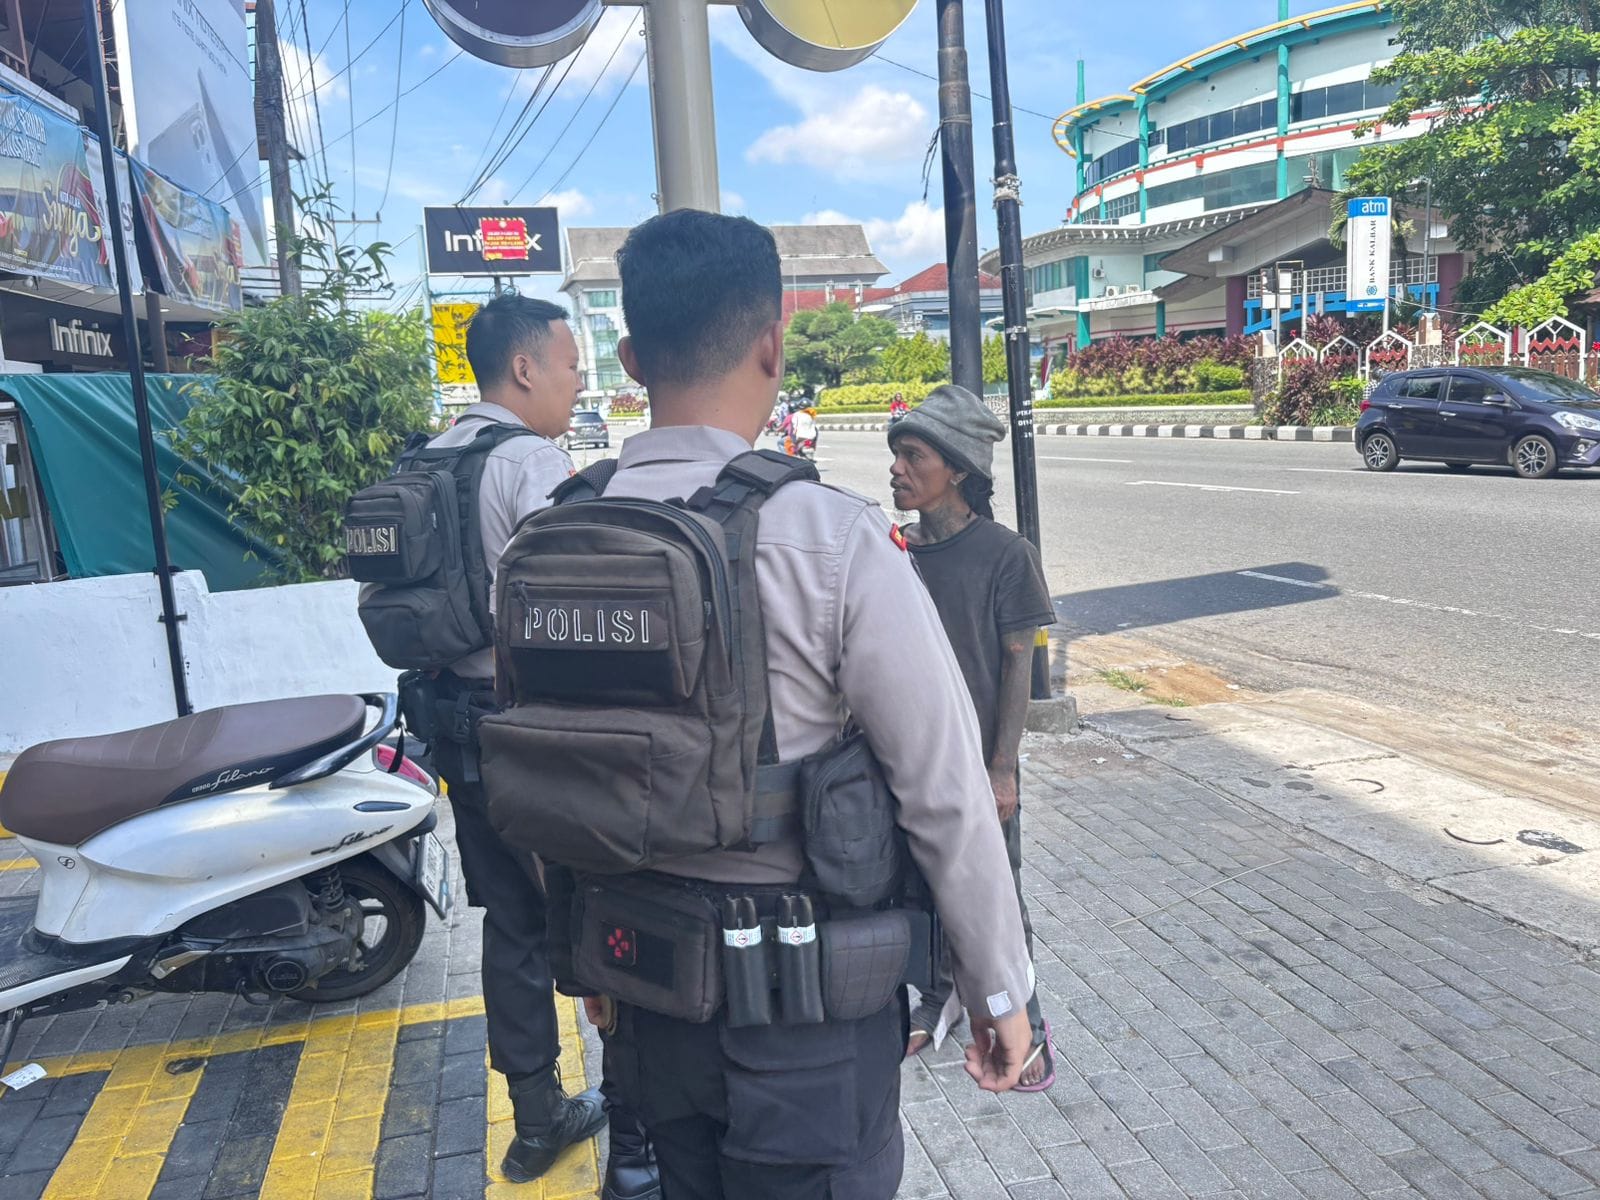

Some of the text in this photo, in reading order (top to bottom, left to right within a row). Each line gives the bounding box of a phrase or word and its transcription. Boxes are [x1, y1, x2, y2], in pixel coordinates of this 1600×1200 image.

[1362, 200, 1385, 213] atm
[445, 230, 543, 252] Infx
[49, 317, 114, 357] Infinix
[346, 527, 396, 553] POLISI
[525, 607, 650, 644] POLISI
[210, 766, 276, 791] Filano
